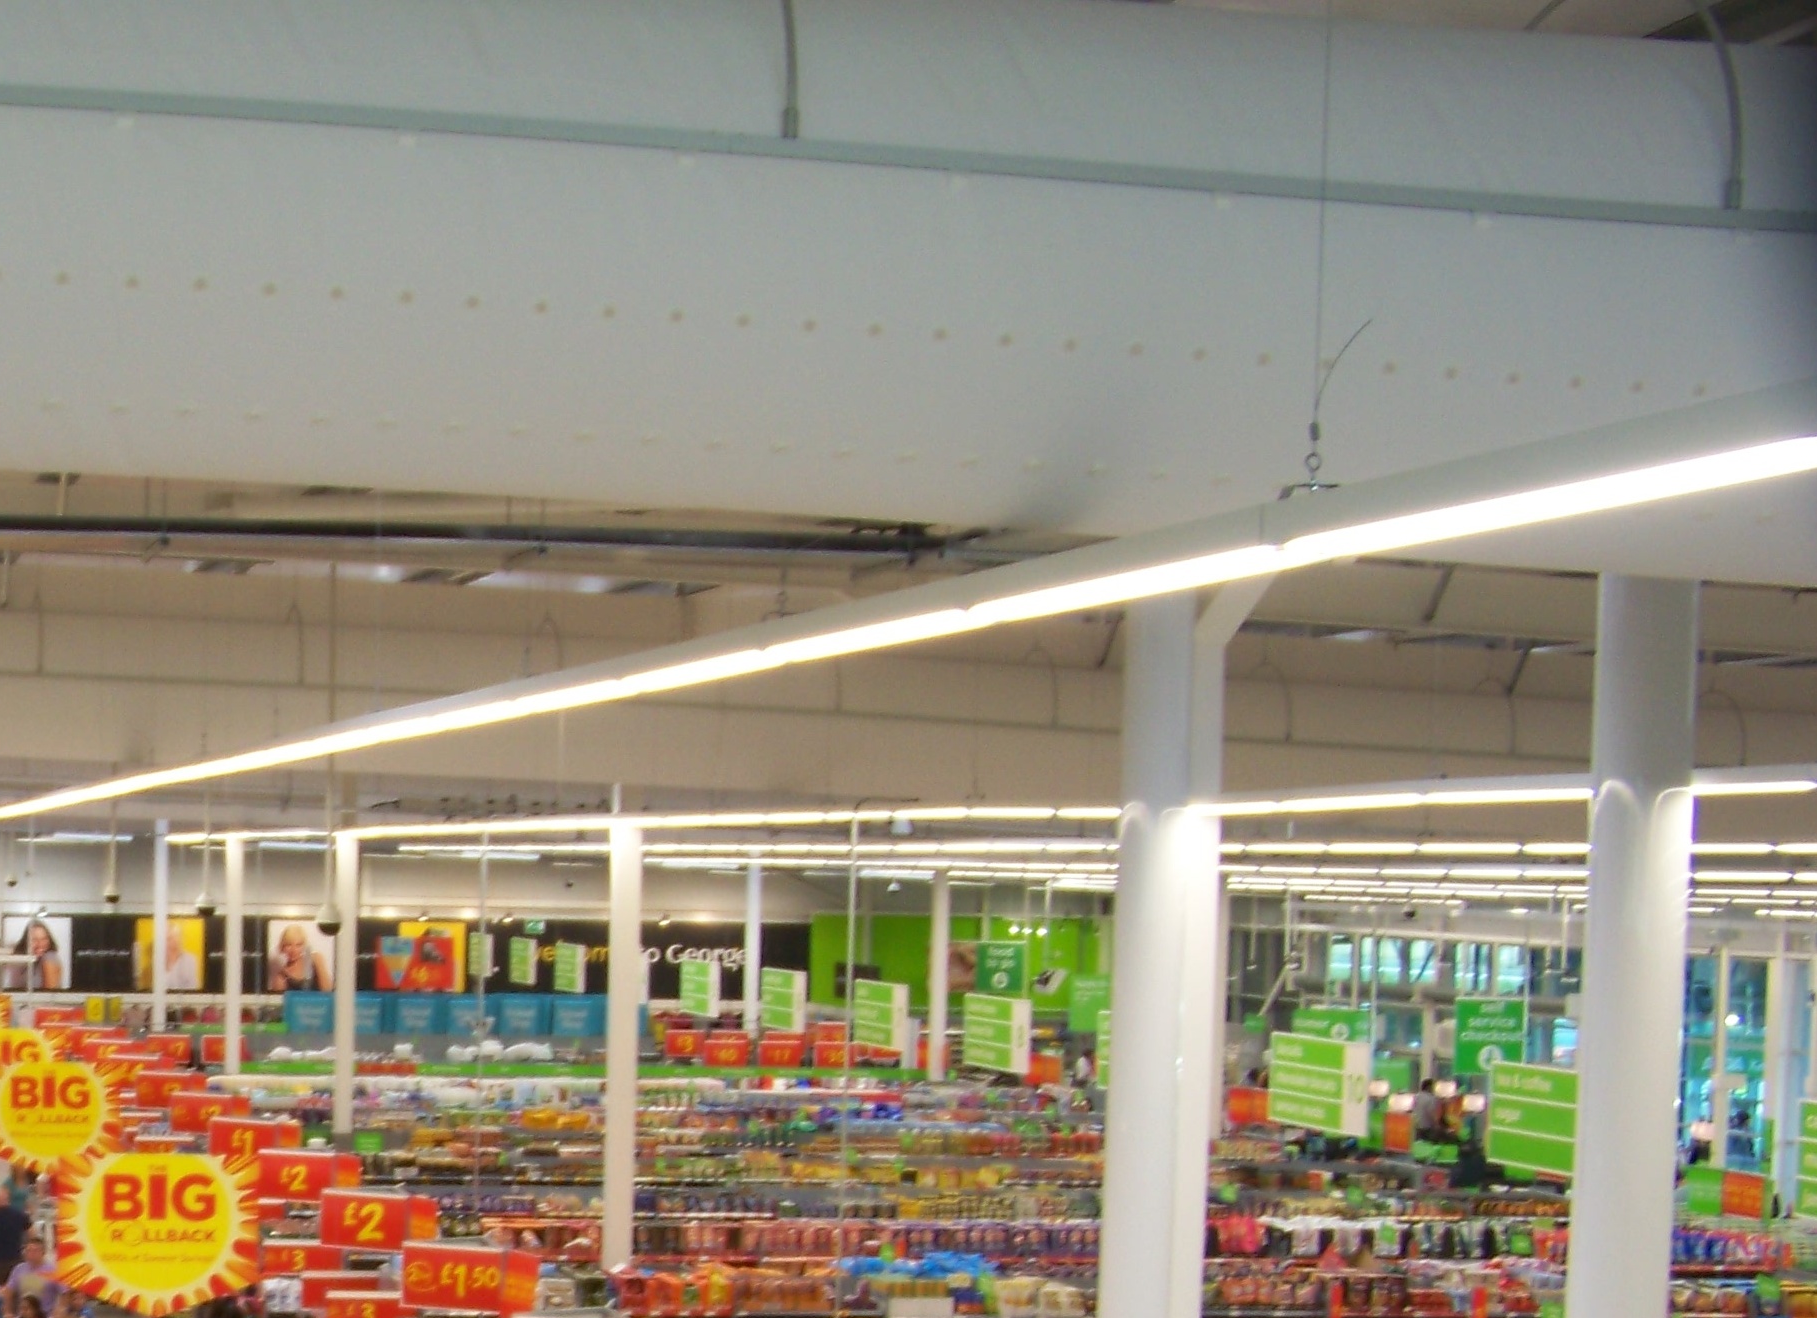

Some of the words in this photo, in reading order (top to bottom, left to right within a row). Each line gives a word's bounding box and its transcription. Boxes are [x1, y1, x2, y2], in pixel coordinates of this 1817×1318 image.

[10, 1075, 91, 1110] BIG
[279, 1164, 308, 1192] £2
[102, 1173, 217, 1222] BIG
[343, 1200, 384, 1242] £2
